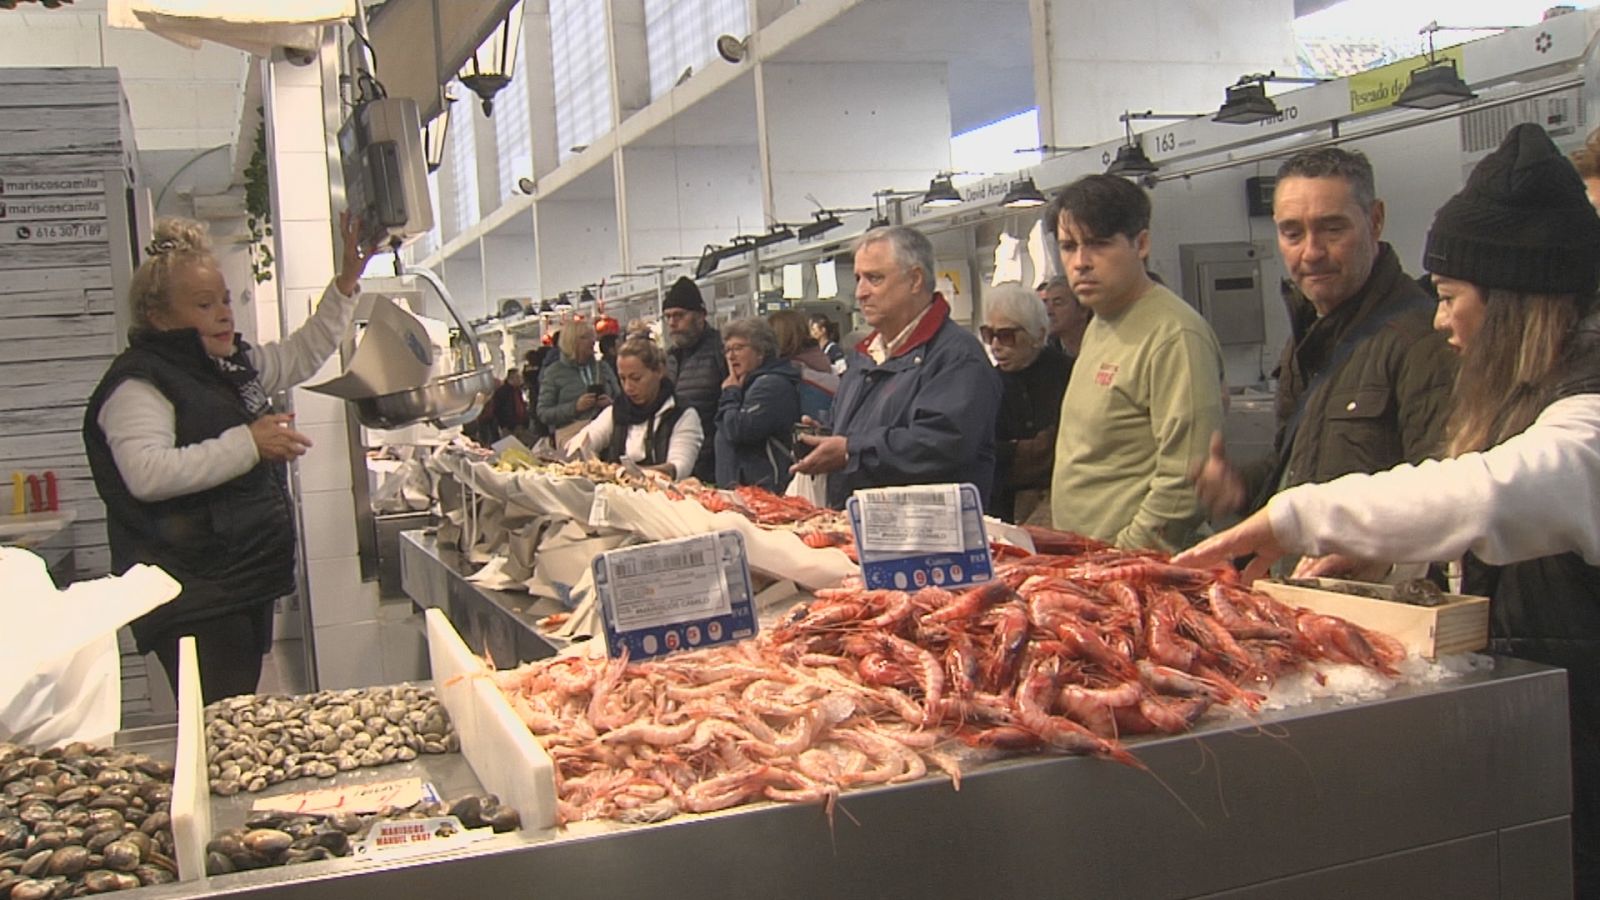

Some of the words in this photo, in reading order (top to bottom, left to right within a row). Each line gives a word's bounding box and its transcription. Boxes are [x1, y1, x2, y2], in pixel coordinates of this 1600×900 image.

[1350, 82, 1389, 111] Pescado
[1156, 132, 1175, 152] 163
[6, 177, 98, 191] mariscoscamilo
[965, 184, 985, 201] David
[8, 201, 100, 215] mariscoscamilo
[36, 226, 57, 238] 616
[59, 225, 79, 237] 307
